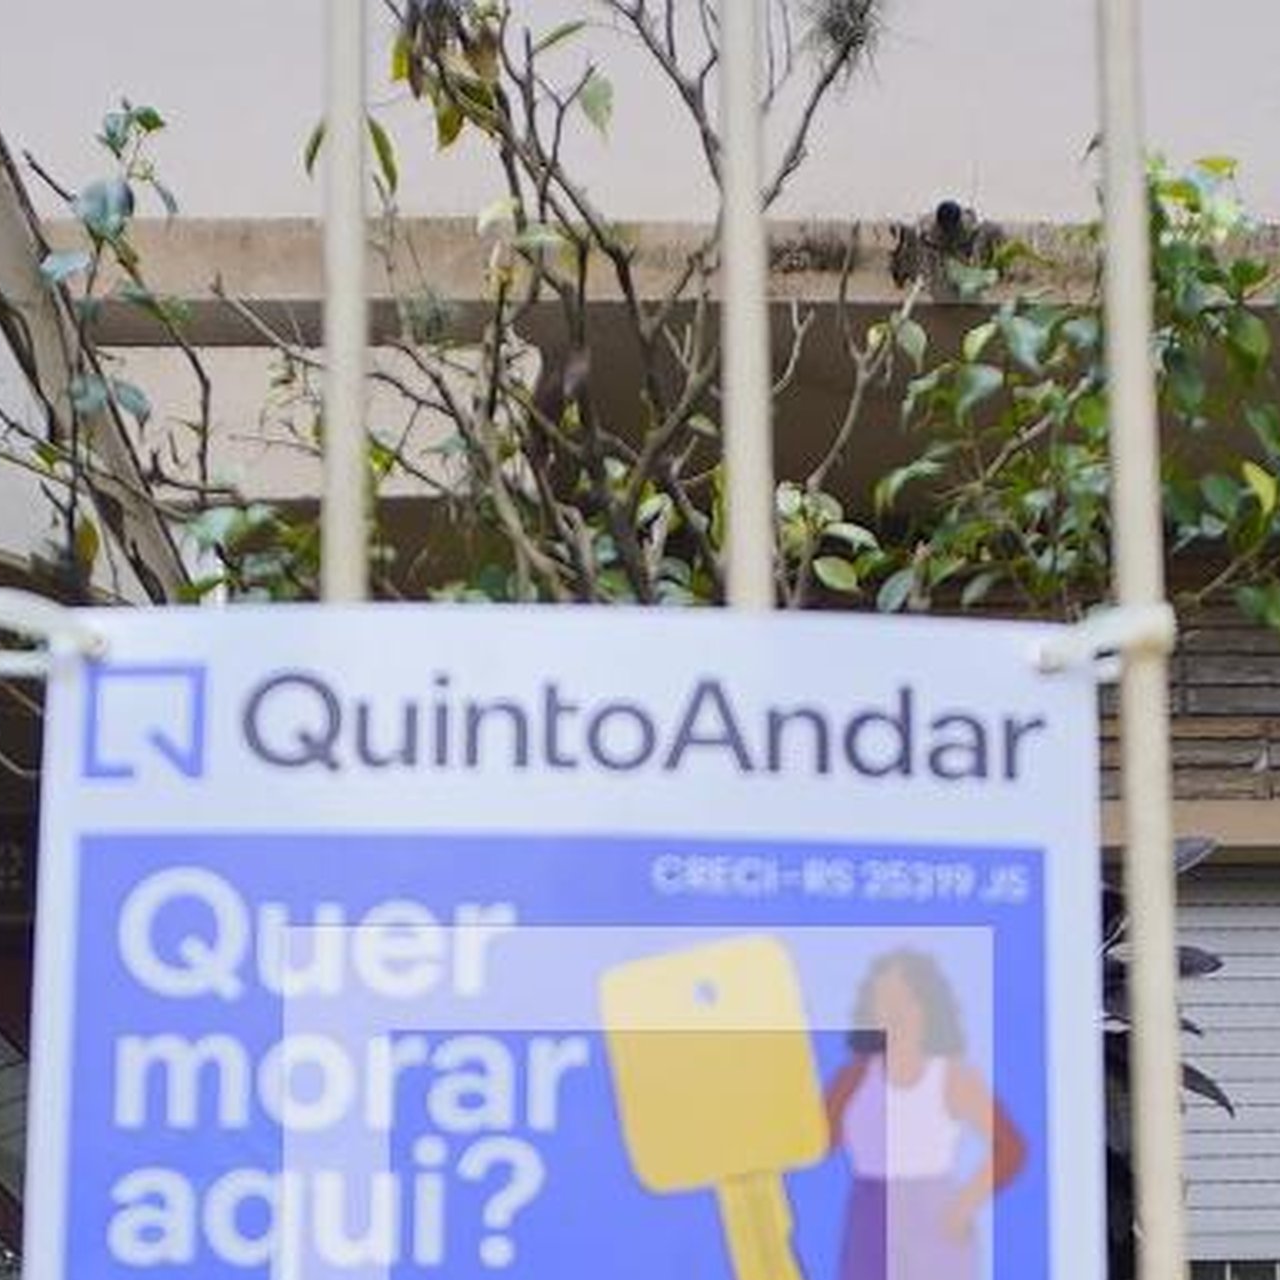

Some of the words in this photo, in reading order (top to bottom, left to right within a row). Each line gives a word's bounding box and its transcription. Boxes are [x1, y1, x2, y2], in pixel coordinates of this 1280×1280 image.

[242, 672, 1044, 782] QuintoAndar
[118, 865, 516, 1000] Quer
[116, 1030, 590, 1133] morar
